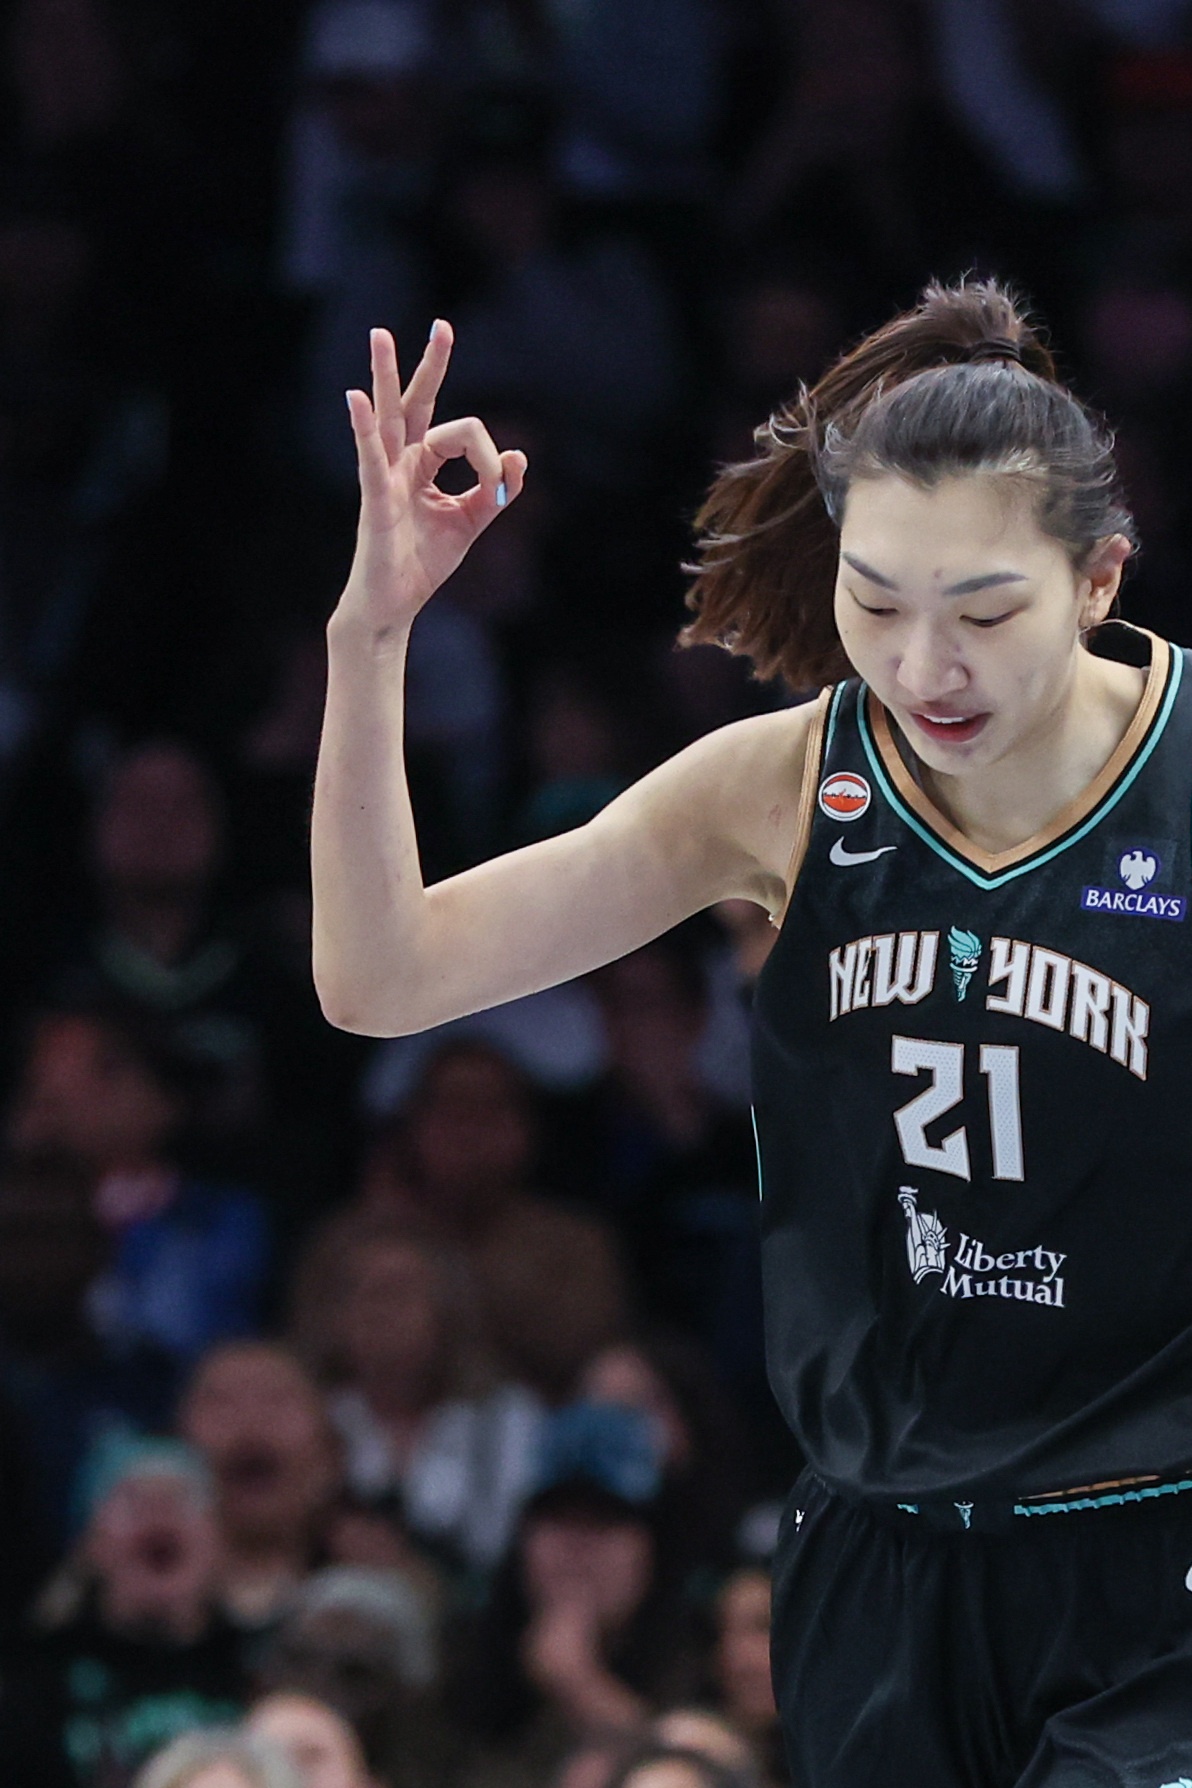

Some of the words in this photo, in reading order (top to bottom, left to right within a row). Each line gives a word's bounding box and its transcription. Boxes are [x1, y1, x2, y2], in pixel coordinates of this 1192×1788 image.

[1085, 889, 1181, 917] BARCLAYS
[829, 930, 940, 1022] NEW
[986, 936, 1150, 1082] YORK
[891, 1034, 1025, 1183] 21
[953, 1233, 1067, 1283] Liberty
[940, 1271, 1066, 1308] Mutual
